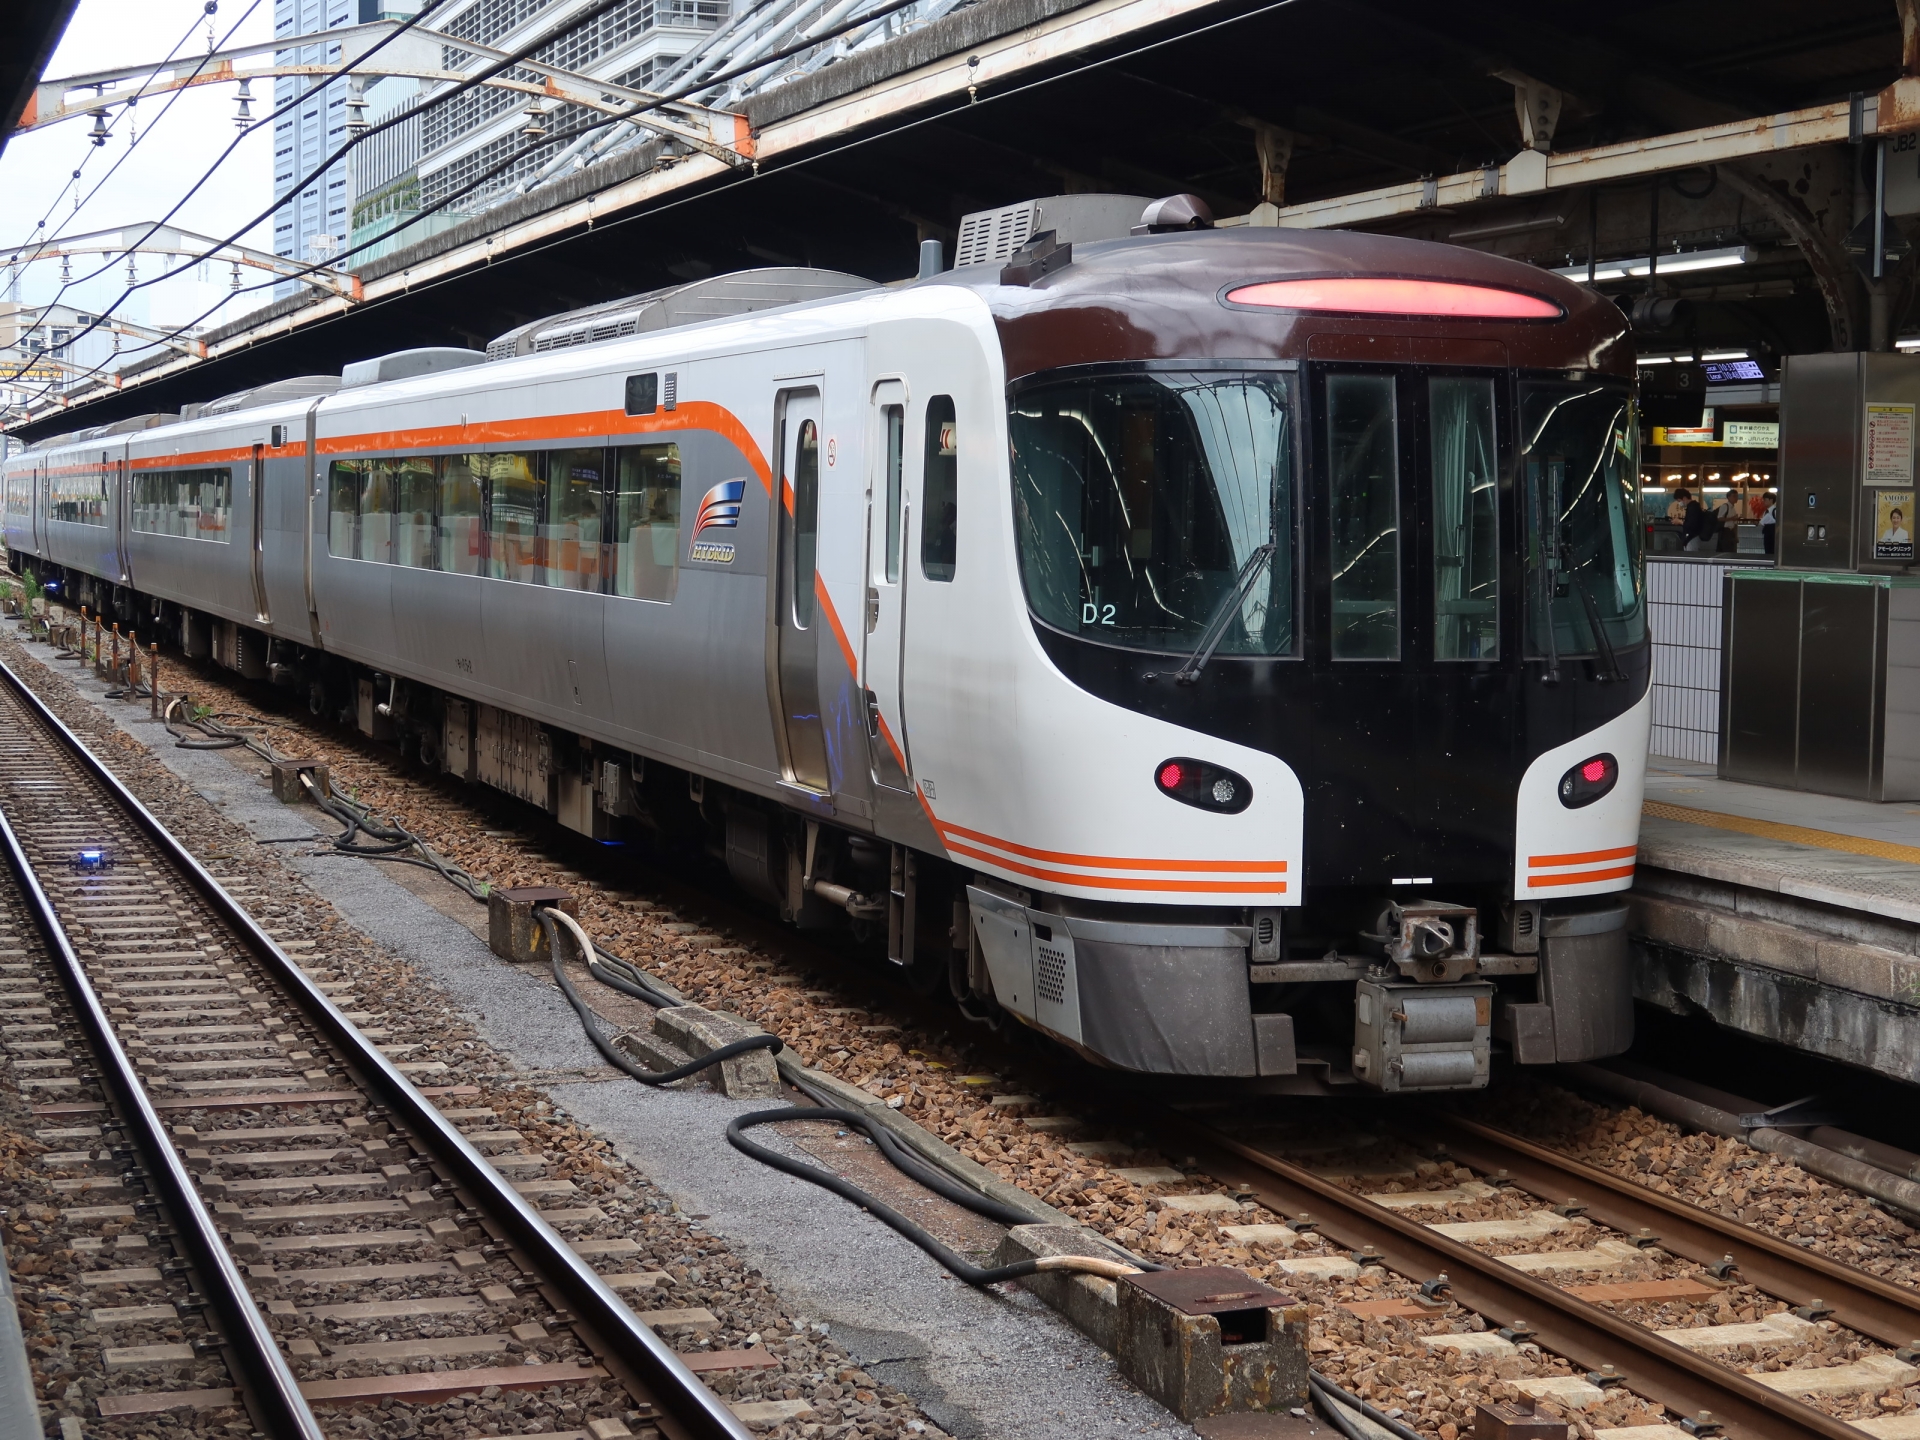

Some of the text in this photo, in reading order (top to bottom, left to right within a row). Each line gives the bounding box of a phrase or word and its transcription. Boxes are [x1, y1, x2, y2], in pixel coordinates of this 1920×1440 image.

[1679, 372, 1690, 388] 3
[693, 543, 735, 563] HYBRID
[1082, 603, 1116, 625] D2
